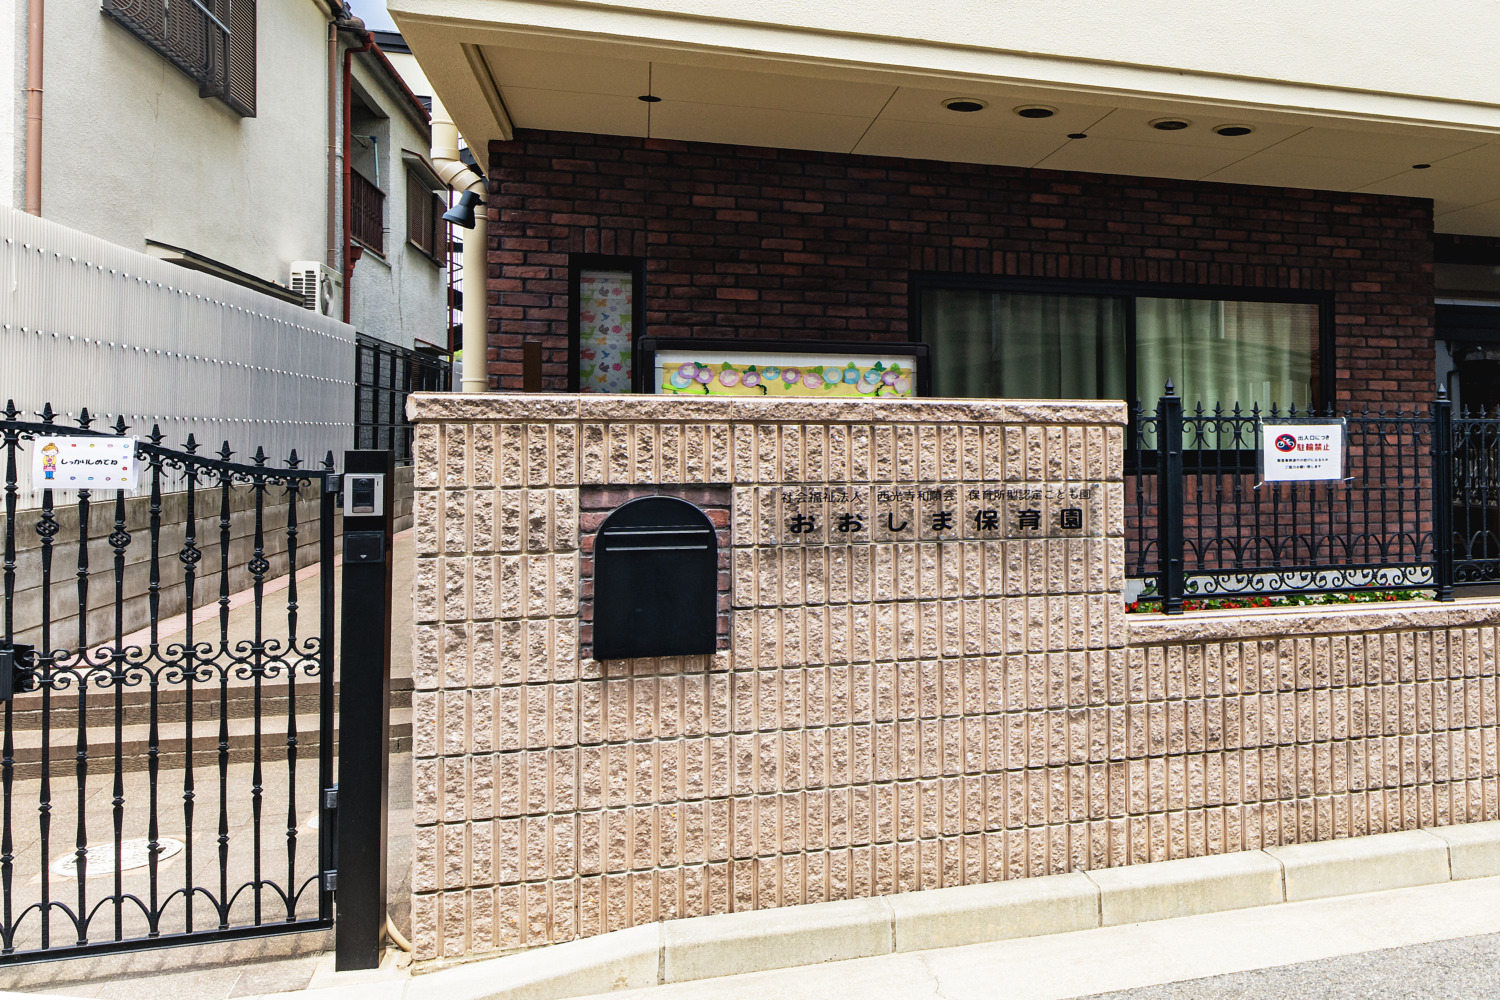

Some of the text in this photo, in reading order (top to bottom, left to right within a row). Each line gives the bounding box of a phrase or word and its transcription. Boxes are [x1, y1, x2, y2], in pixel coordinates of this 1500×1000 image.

[1296, 443, 1330, 452] 駐輪禁止
[780, 490, 864, 504] 社会福祉法人
[968, 488, 1092, 501] 保育所型認定こども園
[789, 508, 1084, 534] おおしま保育園
